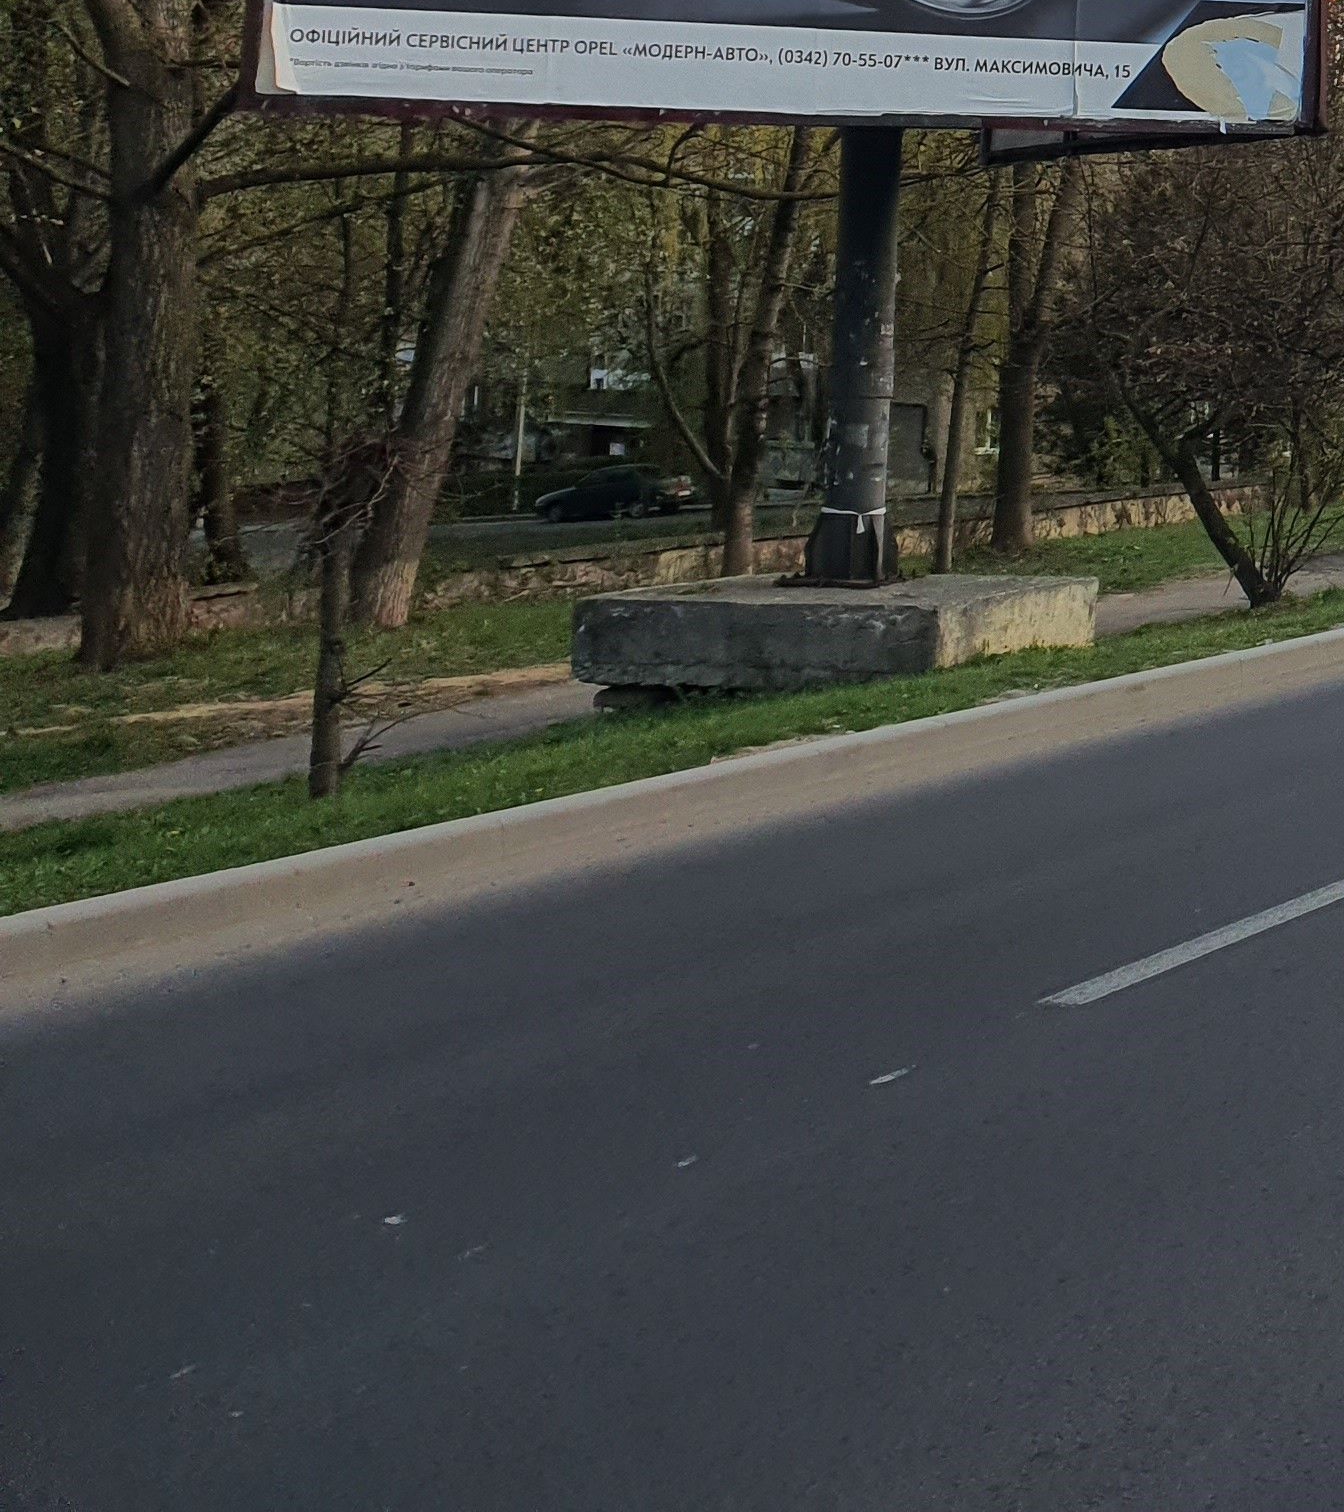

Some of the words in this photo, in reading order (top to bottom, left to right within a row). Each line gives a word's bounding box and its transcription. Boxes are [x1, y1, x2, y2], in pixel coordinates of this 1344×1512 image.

[289, 27, 401, 47] ОФІЦІЙНИЙ
[405, 32, 506, 52] СЕРВІСНИЙ
[512, 38, 570, 56] ЦЕНТР
[574, 40, 618, 56] OPEL
[778, 47, 828, 68] (0342)
[934, 57, 970, 73] ВУЛ.
[974, 59, 1110, 80] МАКСИМОВИЧА,
[1114, 64, 1131, 79] 15
